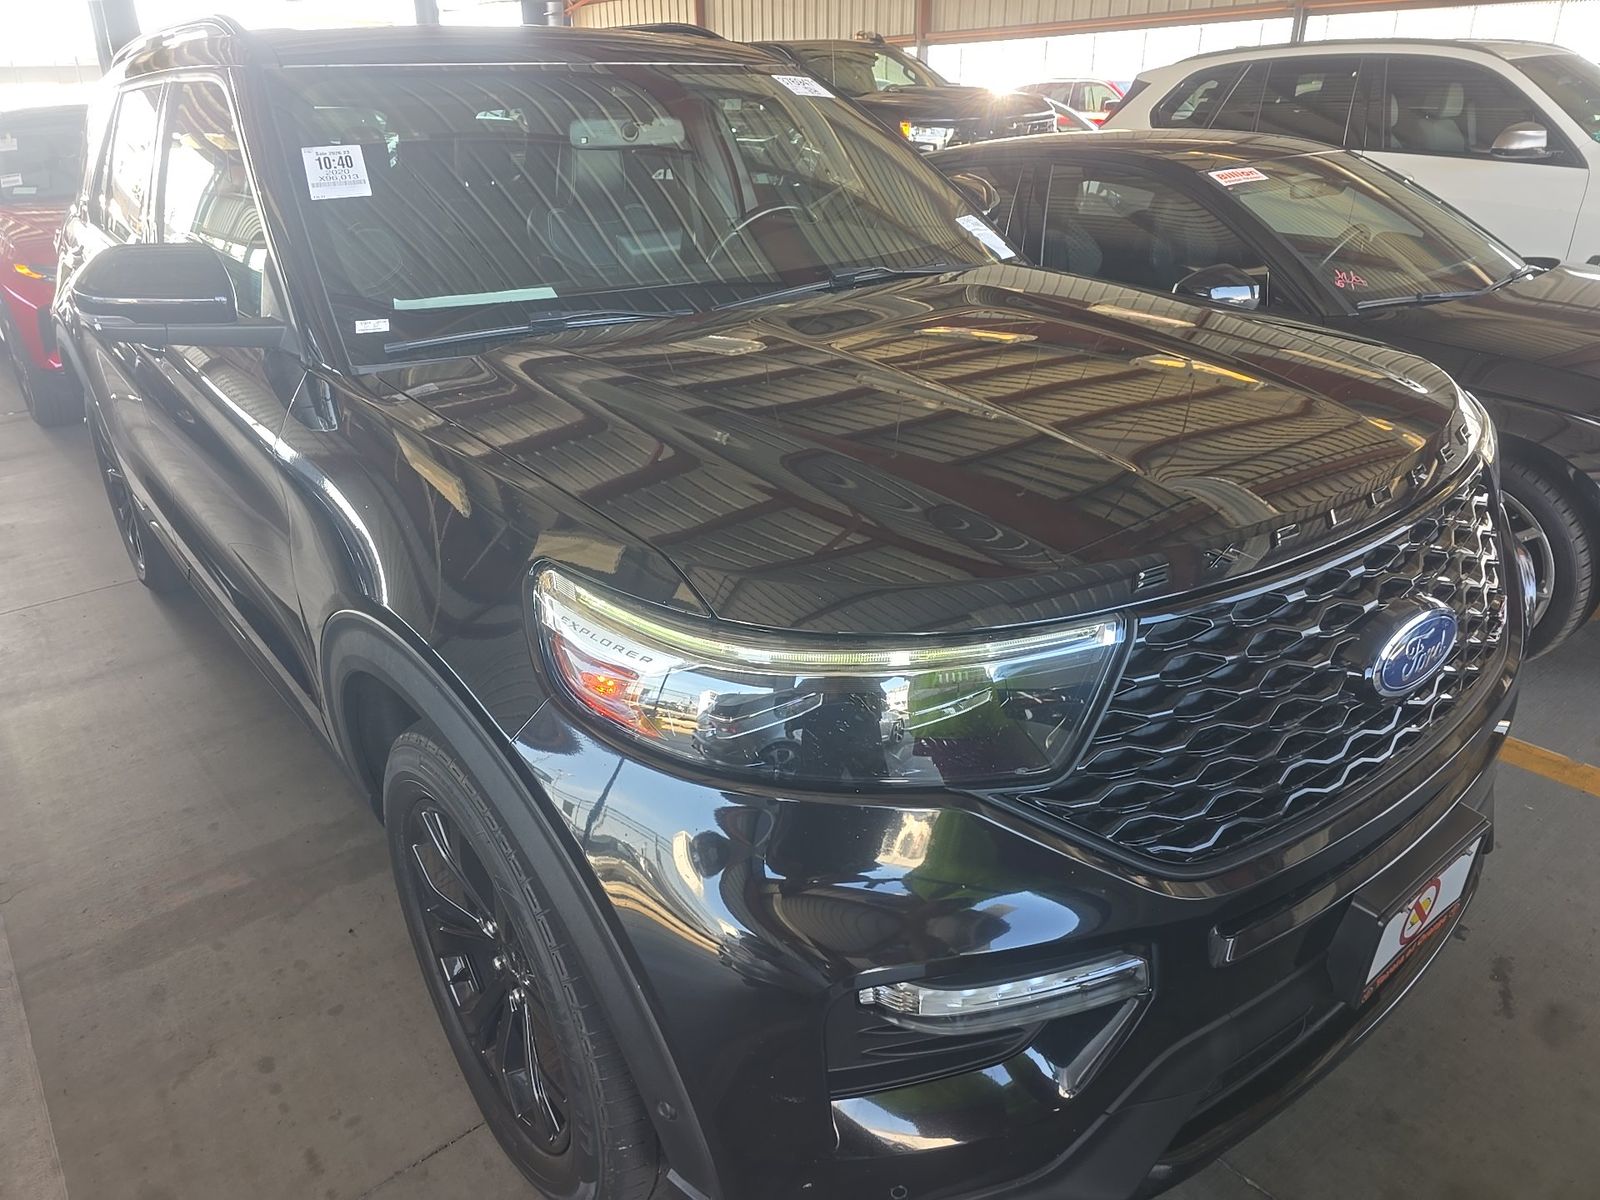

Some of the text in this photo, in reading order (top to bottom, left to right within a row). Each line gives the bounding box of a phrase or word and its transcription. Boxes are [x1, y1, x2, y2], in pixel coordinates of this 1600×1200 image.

[315, 155, 353, 170] 10:40
[1132, 422, 1474, 594] EXPLORER
[560, 615, 653, 663] EXPLORER
[1402, 627, 1446, 681] Ford
